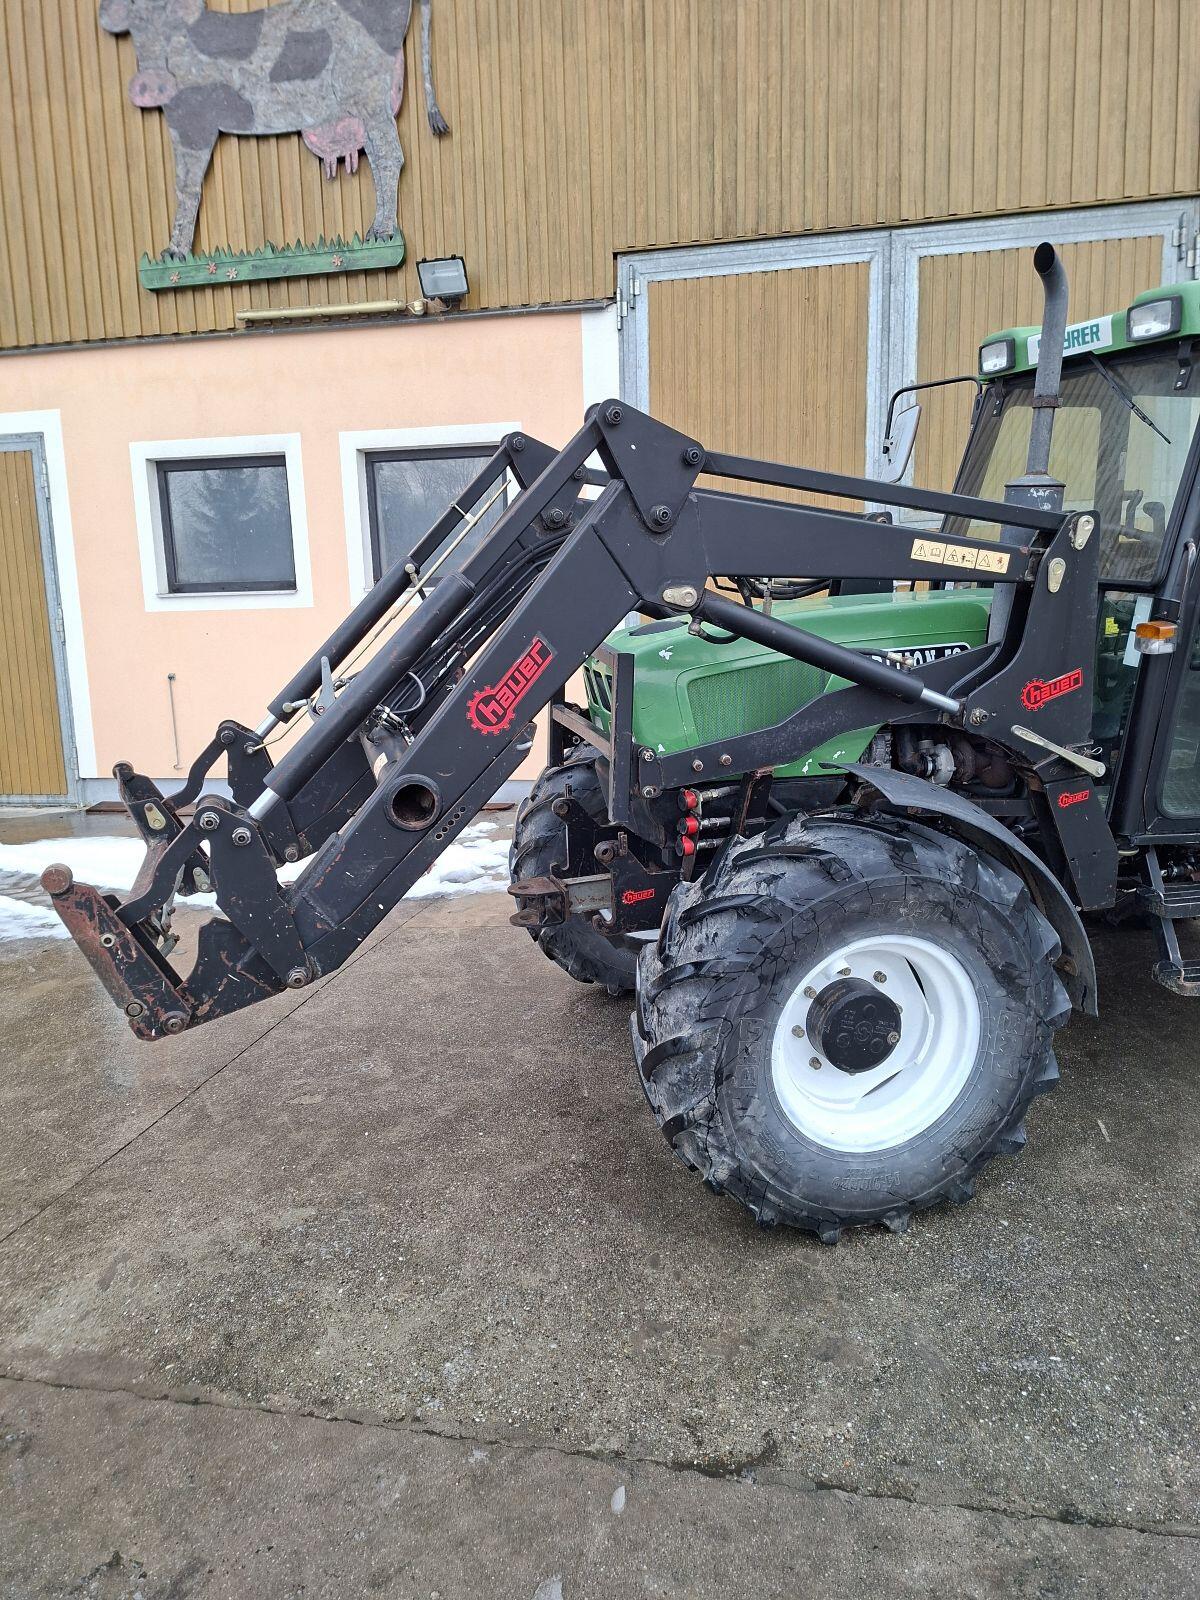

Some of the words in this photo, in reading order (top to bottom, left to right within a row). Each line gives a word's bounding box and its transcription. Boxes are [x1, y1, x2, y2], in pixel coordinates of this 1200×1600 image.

[1037, 323, 1101, 351] YRER
[476, 640, 544, 725] hauer
[1029, 672, 1080, 704] hauer
[1062, 791, 1089, 806] hauer
[626, 889, 653, 902] hauer
